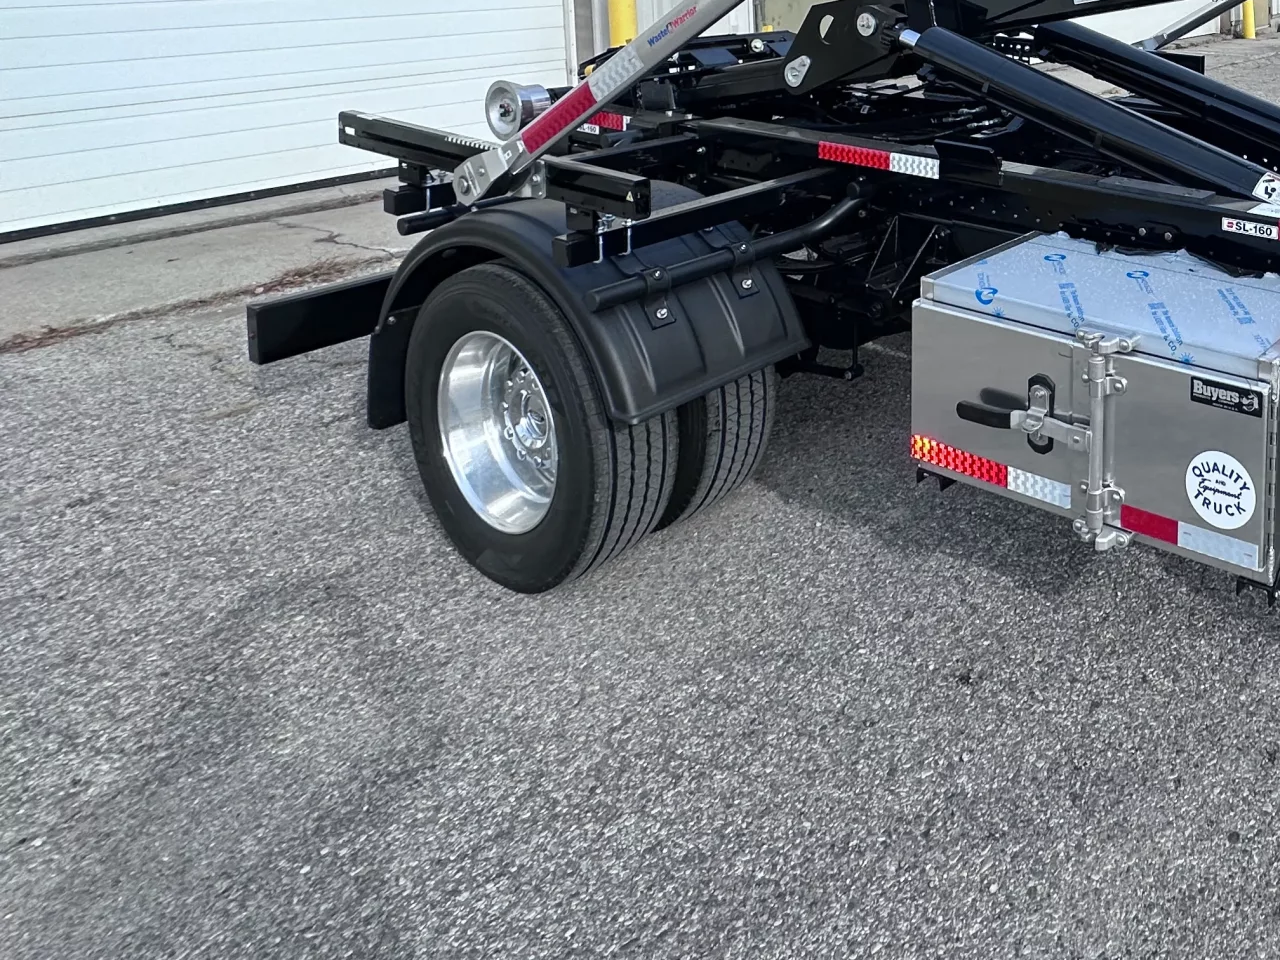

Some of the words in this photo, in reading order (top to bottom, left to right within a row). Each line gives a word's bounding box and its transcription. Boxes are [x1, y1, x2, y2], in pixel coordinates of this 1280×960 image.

[646, 28, 669, 47] Waste
[671, 6, 698, 29] Warrior
[1235, 221, 1273, 237] SL-160
[1193, 379, 1240, 403] Buyers
[1192, 461, 1251, 490] QUALITY
[1194, 489, 1247, 517] TRUCK
